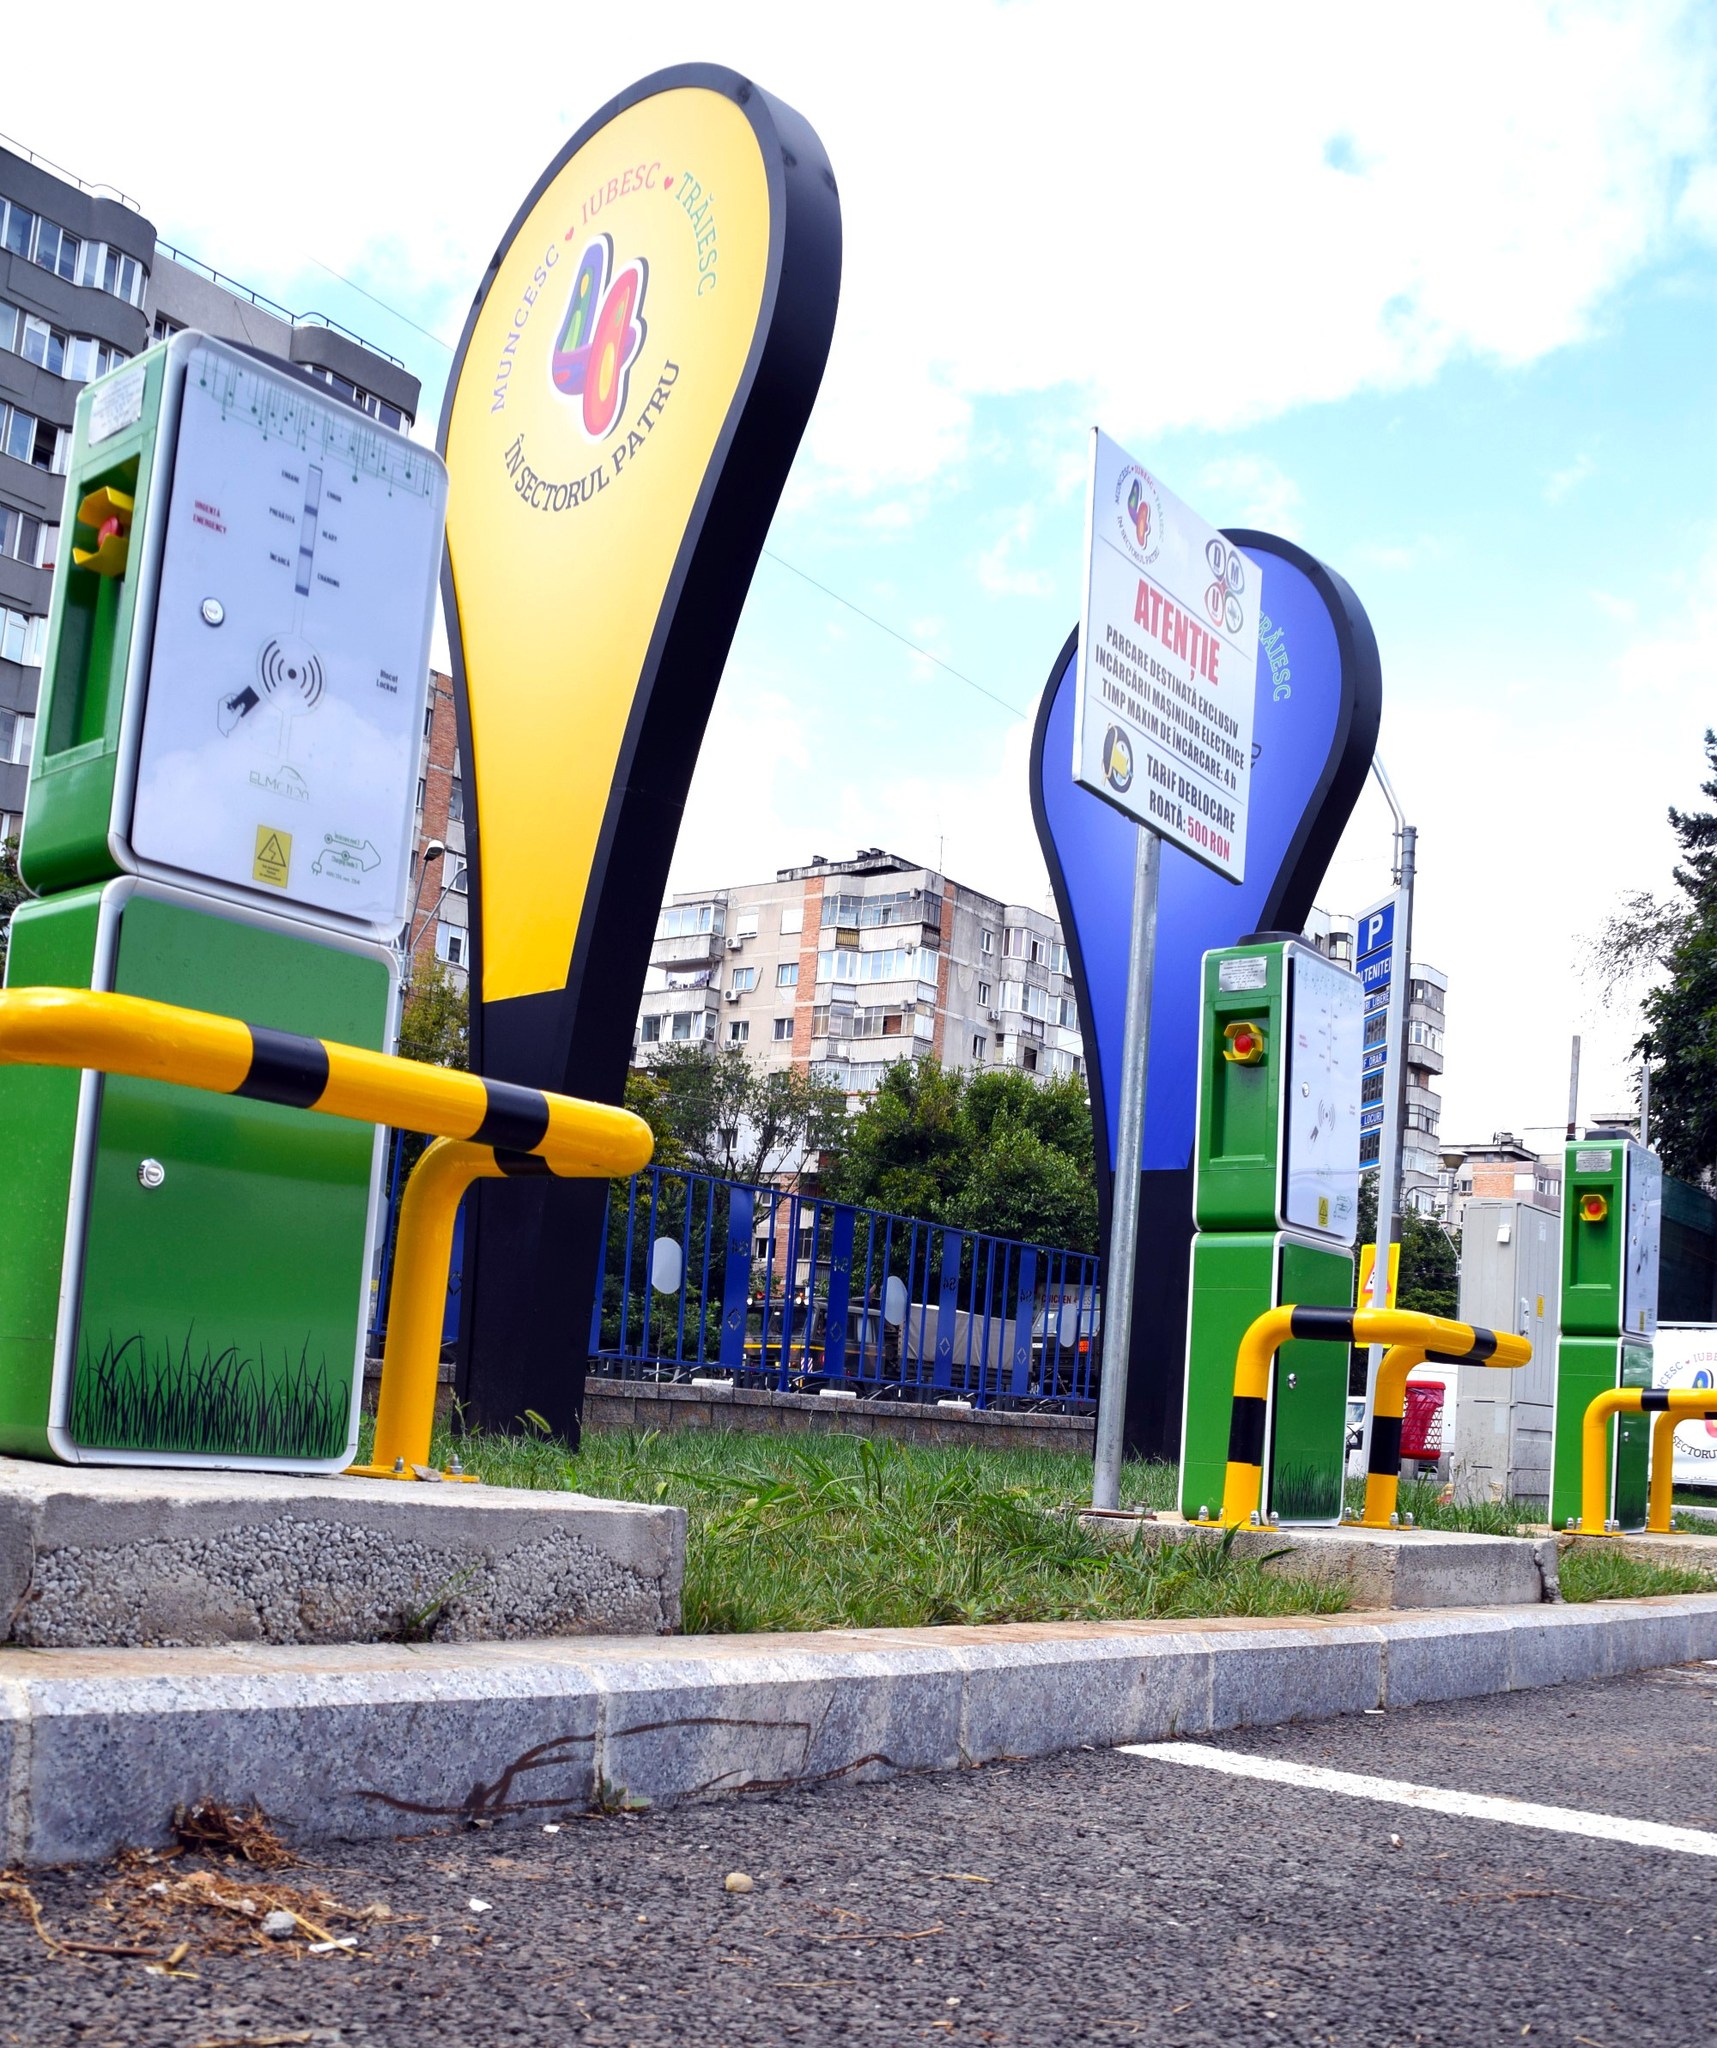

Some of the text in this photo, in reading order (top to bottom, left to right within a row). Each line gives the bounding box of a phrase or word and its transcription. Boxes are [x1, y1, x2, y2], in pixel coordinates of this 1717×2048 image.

[490, 161, 719, 415] MUNCESC IUBESC TRĂIESC
[504, 359, 681, 513] ÎN SECTORUL PATRU
[1211, 588, 1219, 613] U
[1230, 561, 1240, 586] M
[1106, 624, 1239, 740] PARCARE DESTINATĂ EXCLUSIV
[1134, 577, 1220, 687] ATENȚIE
[1258, 611, 1292, 703] RĂIESC
[1095, 643, 1151, 702] INCĂRCĂRII
[1152, 684, 1201, 739] MAȘINILOR
[1201, 724, 1245, 771] ELECTRICE
[1102, 677, 1126, 710] TIMP
[1127, 696, 1159, 736] MAXIM
[1160, 720, 1171, 744] DE
[1223, 762, 1230, 786] 4
[1230, 767, 1237, 792] h
[1147, 753, 1236, 834] TARIF DEBLOCARE
[1149, 788, 1231, 863] ROATĂ: 500 RON
[1368, 913, 1384, 951] P
